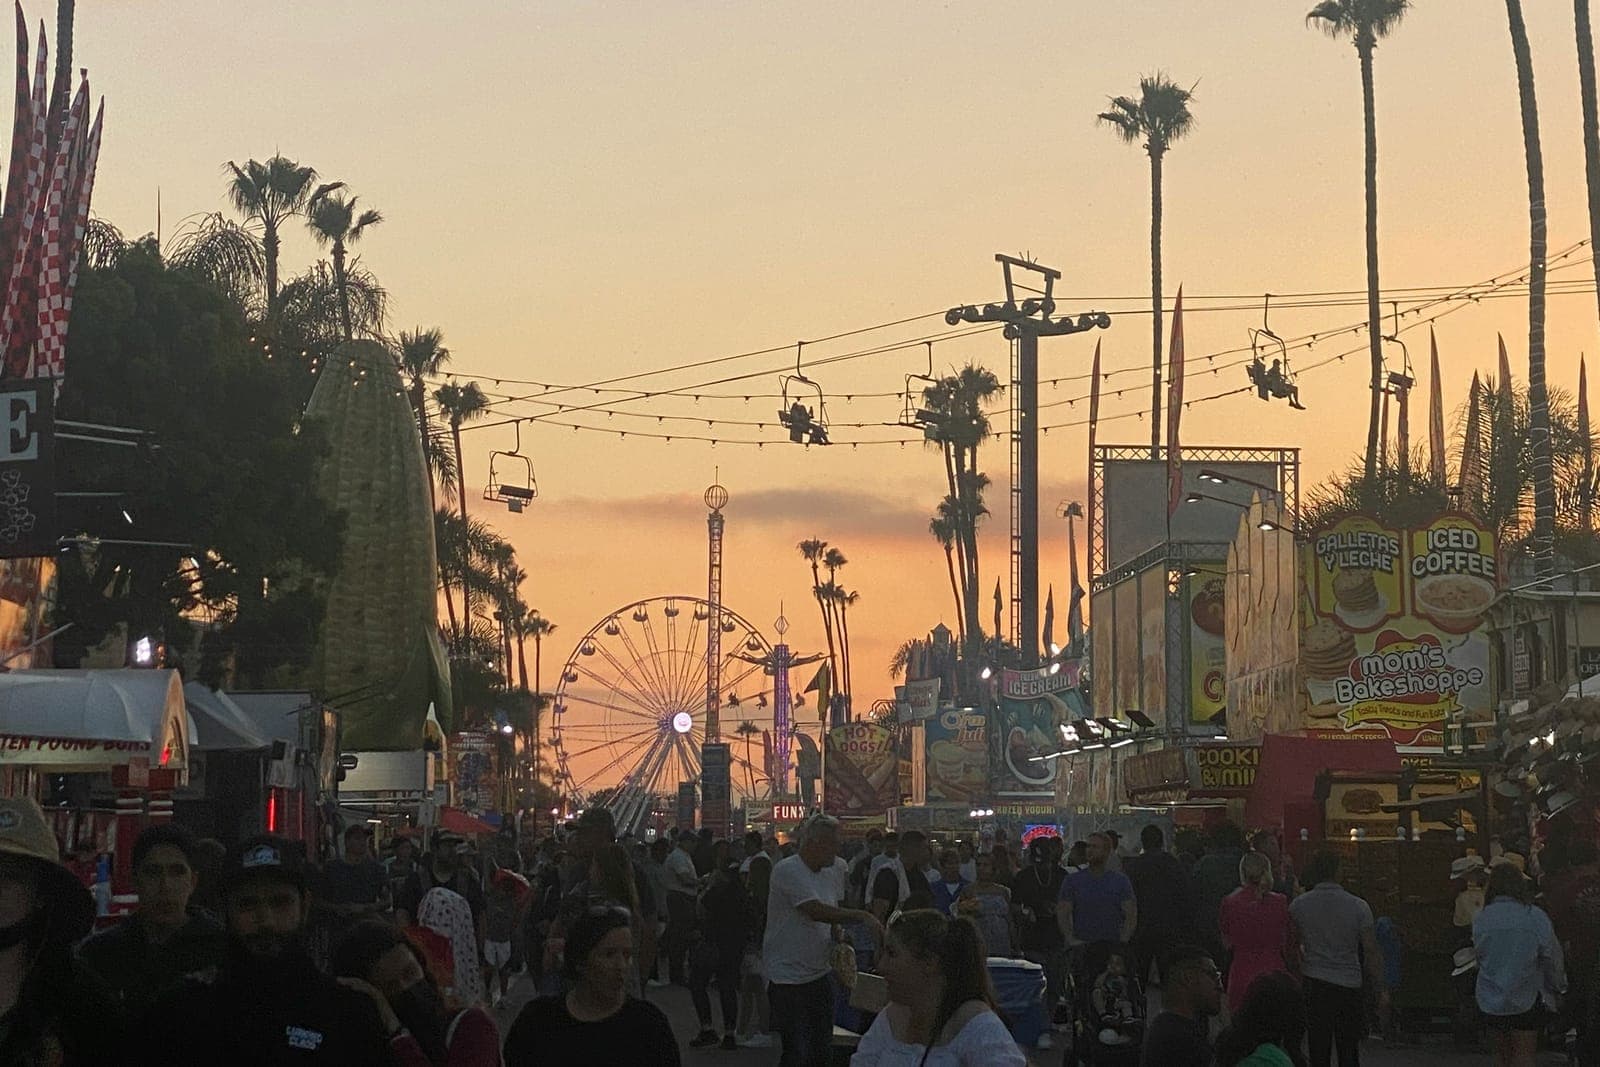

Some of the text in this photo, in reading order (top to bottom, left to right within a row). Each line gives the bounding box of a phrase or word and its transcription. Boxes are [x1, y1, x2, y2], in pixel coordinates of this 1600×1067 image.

[1316, 531, 1399, 556] GALLETAS
[1427, 527, 1478, 550] ICED
[1324, 550, 1393, 572] Y LECHE
[1411, 550, 1496, 577] COFFEE
[1008, 680, 1028, 695] ICE
[1030, 673, 1072, 694] CREAM
[1336, 667, 1483, 703] Bakeshoppe
[845, 726, 877, 739] HOT
[1202, 768, 1216, 786] &
